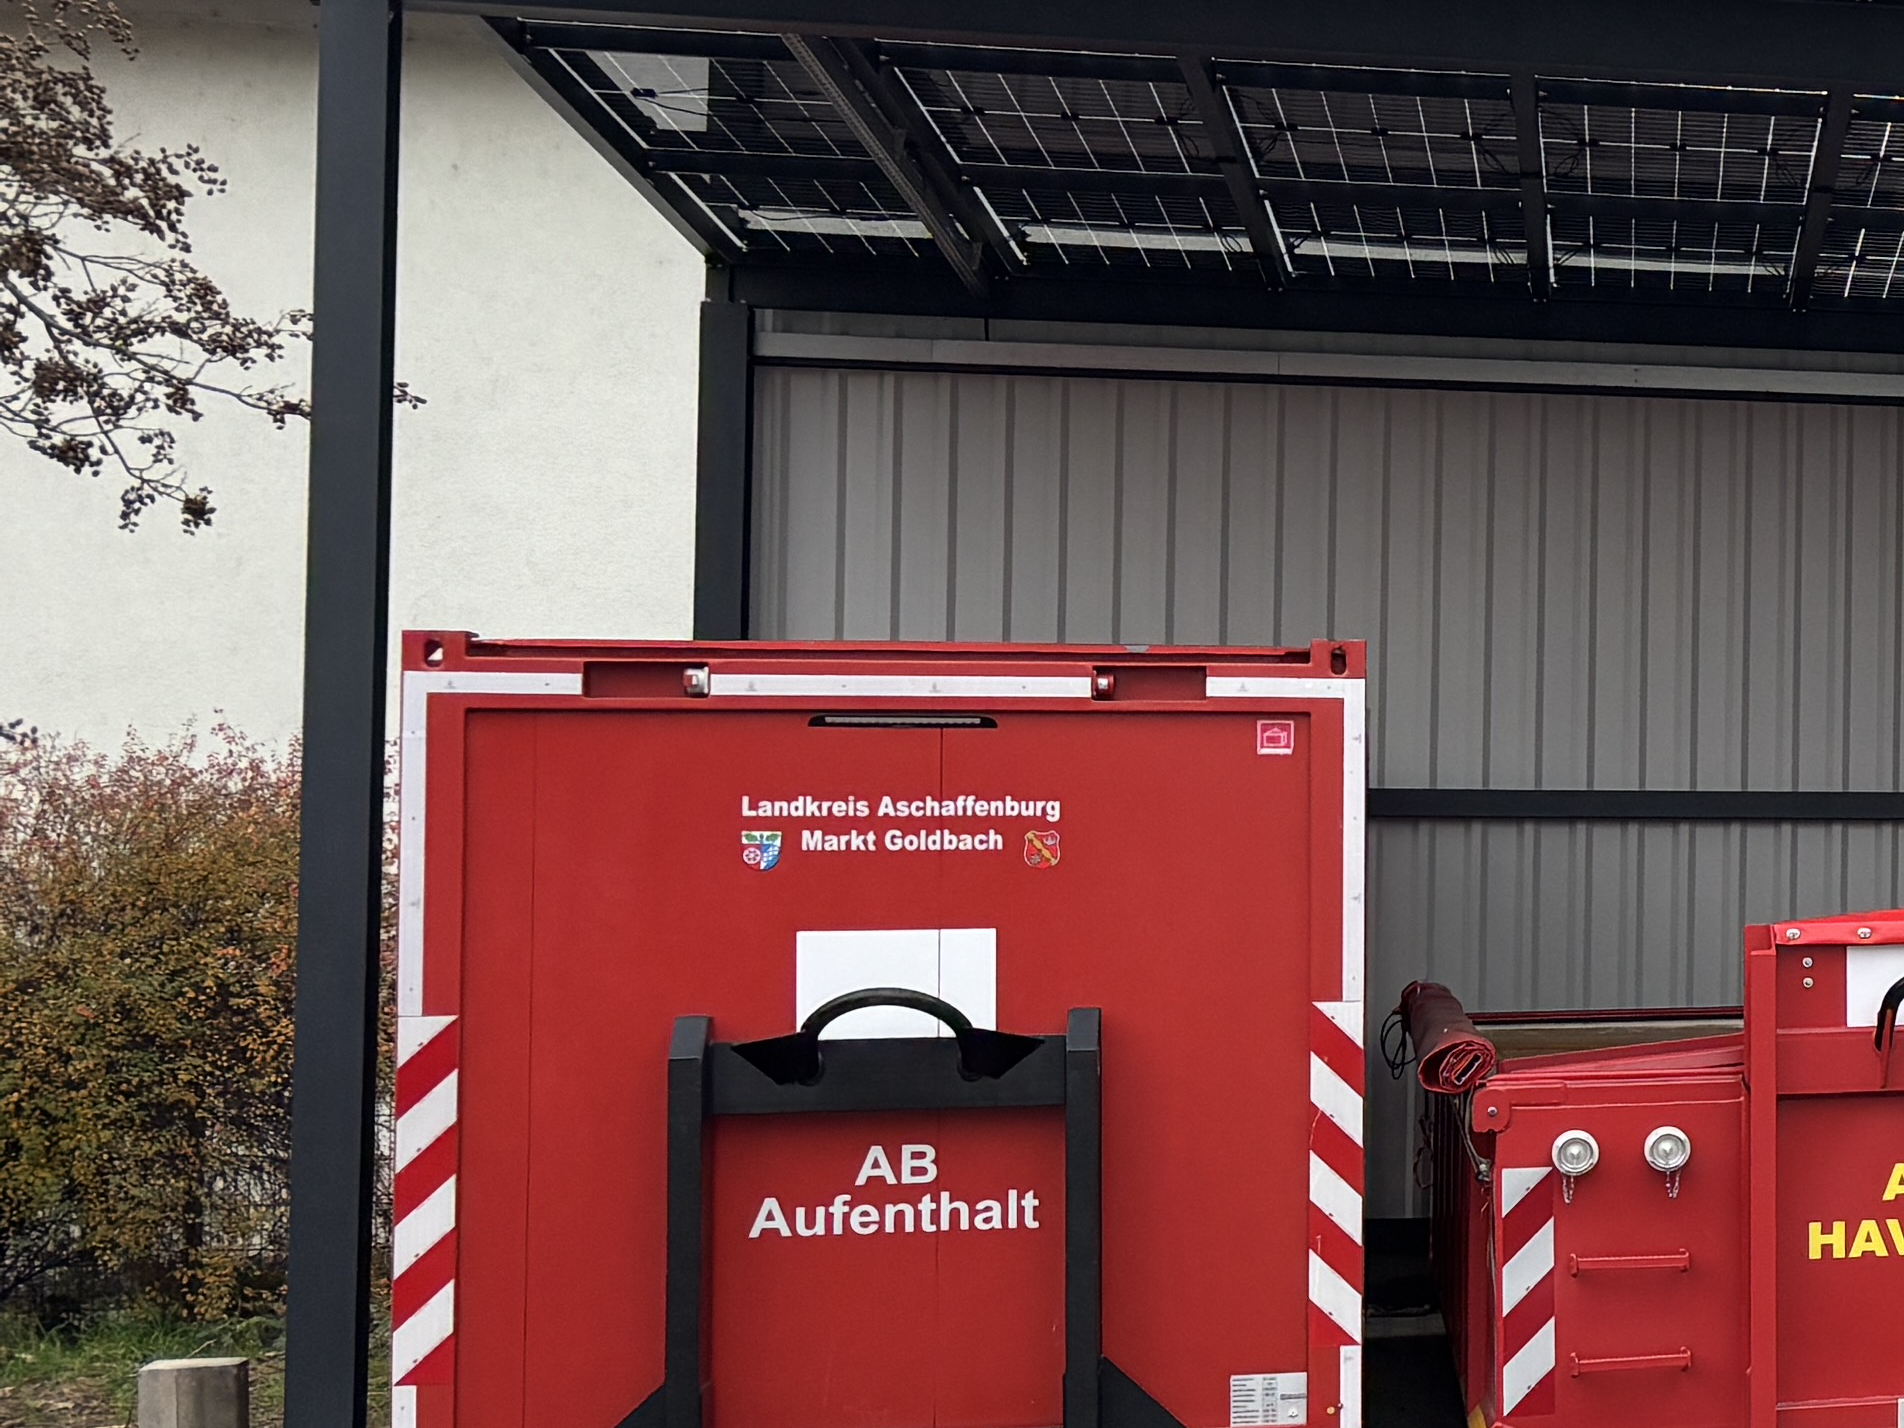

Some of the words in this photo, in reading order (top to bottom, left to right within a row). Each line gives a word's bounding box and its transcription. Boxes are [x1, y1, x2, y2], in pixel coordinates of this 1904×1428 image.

[741, 795, 870, 818] Landkreis
[876, 795, 1062, 823] Aschaffenburg
[801, 829, 876, 852] Markt
[884, 829, 1004, 852] Goldbach
[853, 1144, 938, 1187] AB
[748, 1188, 1041, 1240] Aufenthalt
